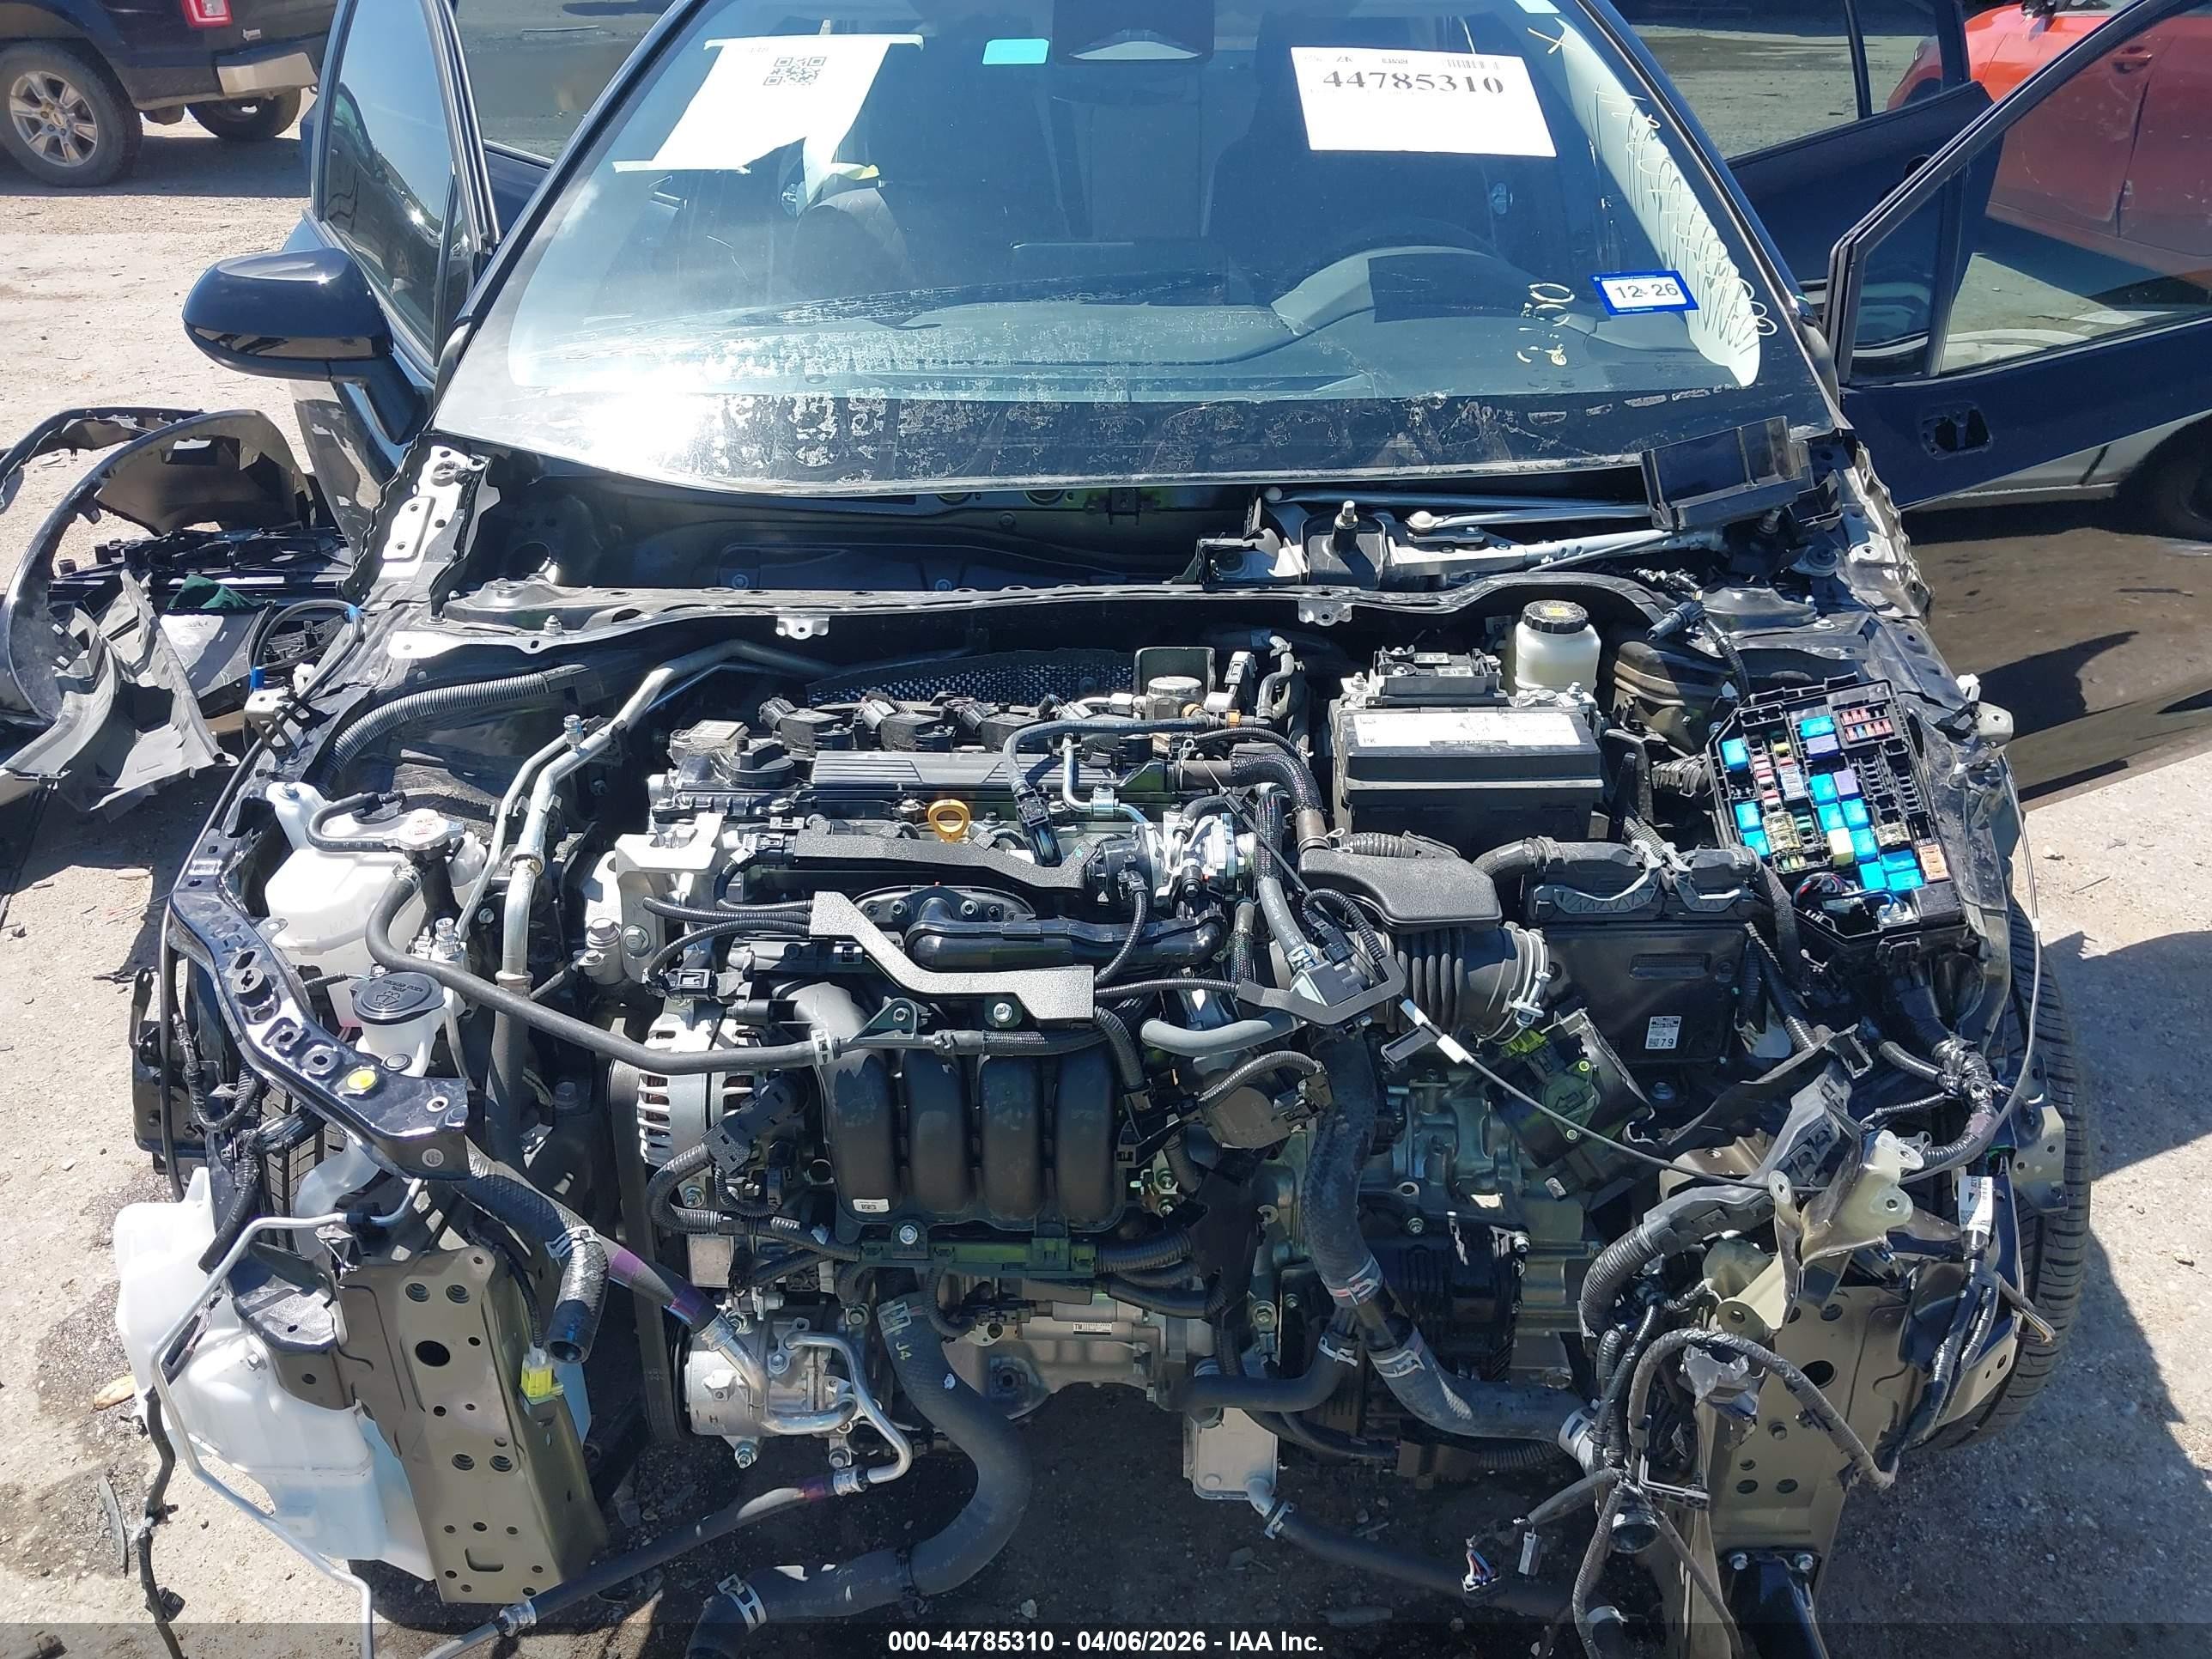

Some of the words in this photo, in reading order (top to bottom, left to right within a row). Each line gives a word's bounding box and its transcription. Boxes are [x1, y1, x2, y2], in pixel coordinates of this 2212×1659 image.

[1323, 70, 1504, 94] 44785310
[1615, 285, 1643, 299] 12
[1651, 283, 1679, 296] 26
